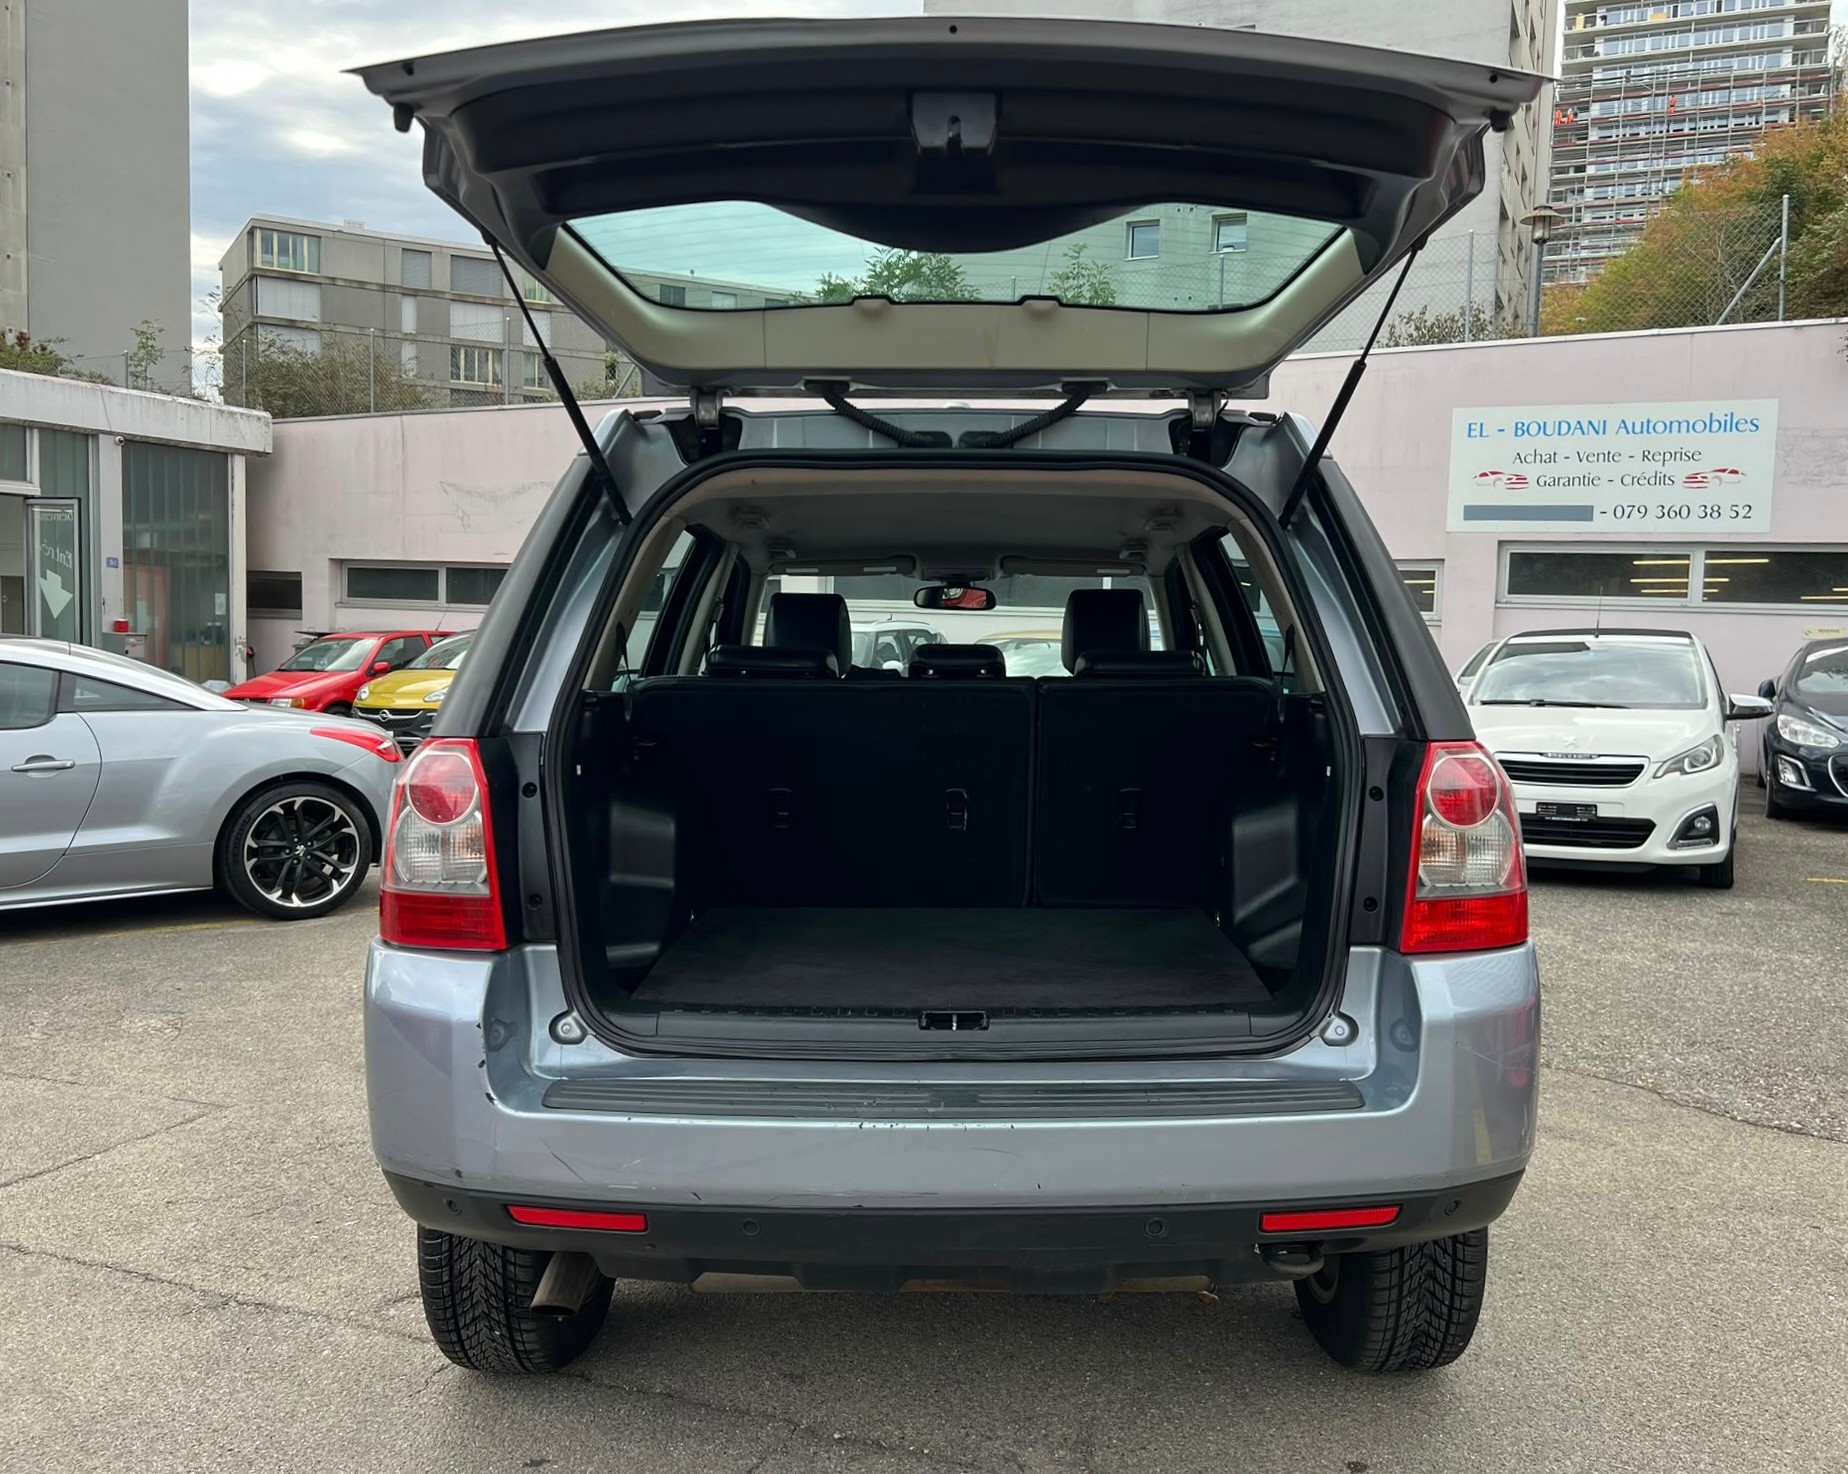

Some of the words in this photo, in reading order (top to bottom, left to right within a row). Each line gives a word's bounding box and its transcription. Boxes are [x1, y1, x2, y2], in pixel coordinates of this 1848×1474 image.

[1467, 422, 1489, 438] EL
[1514, 420, 1607, 437] BOUDANI
[1615, 412, 1760, 435] Automobiles
[1512, 449, 1558, 464] Achat
[1576, 450, 1622, 463] Vente
[1642, 447, 1702, 467] Reprise
[1536, 472, 1601, 488] Garantie
[1620, 470, 1675, 487] Crédits
[1613, 504, 1648, 520] 079
[1655, 504, 1691, 520] 360
[1697, 504, 1721, 520] 38
[1729, 504, 1753, 520] 52
